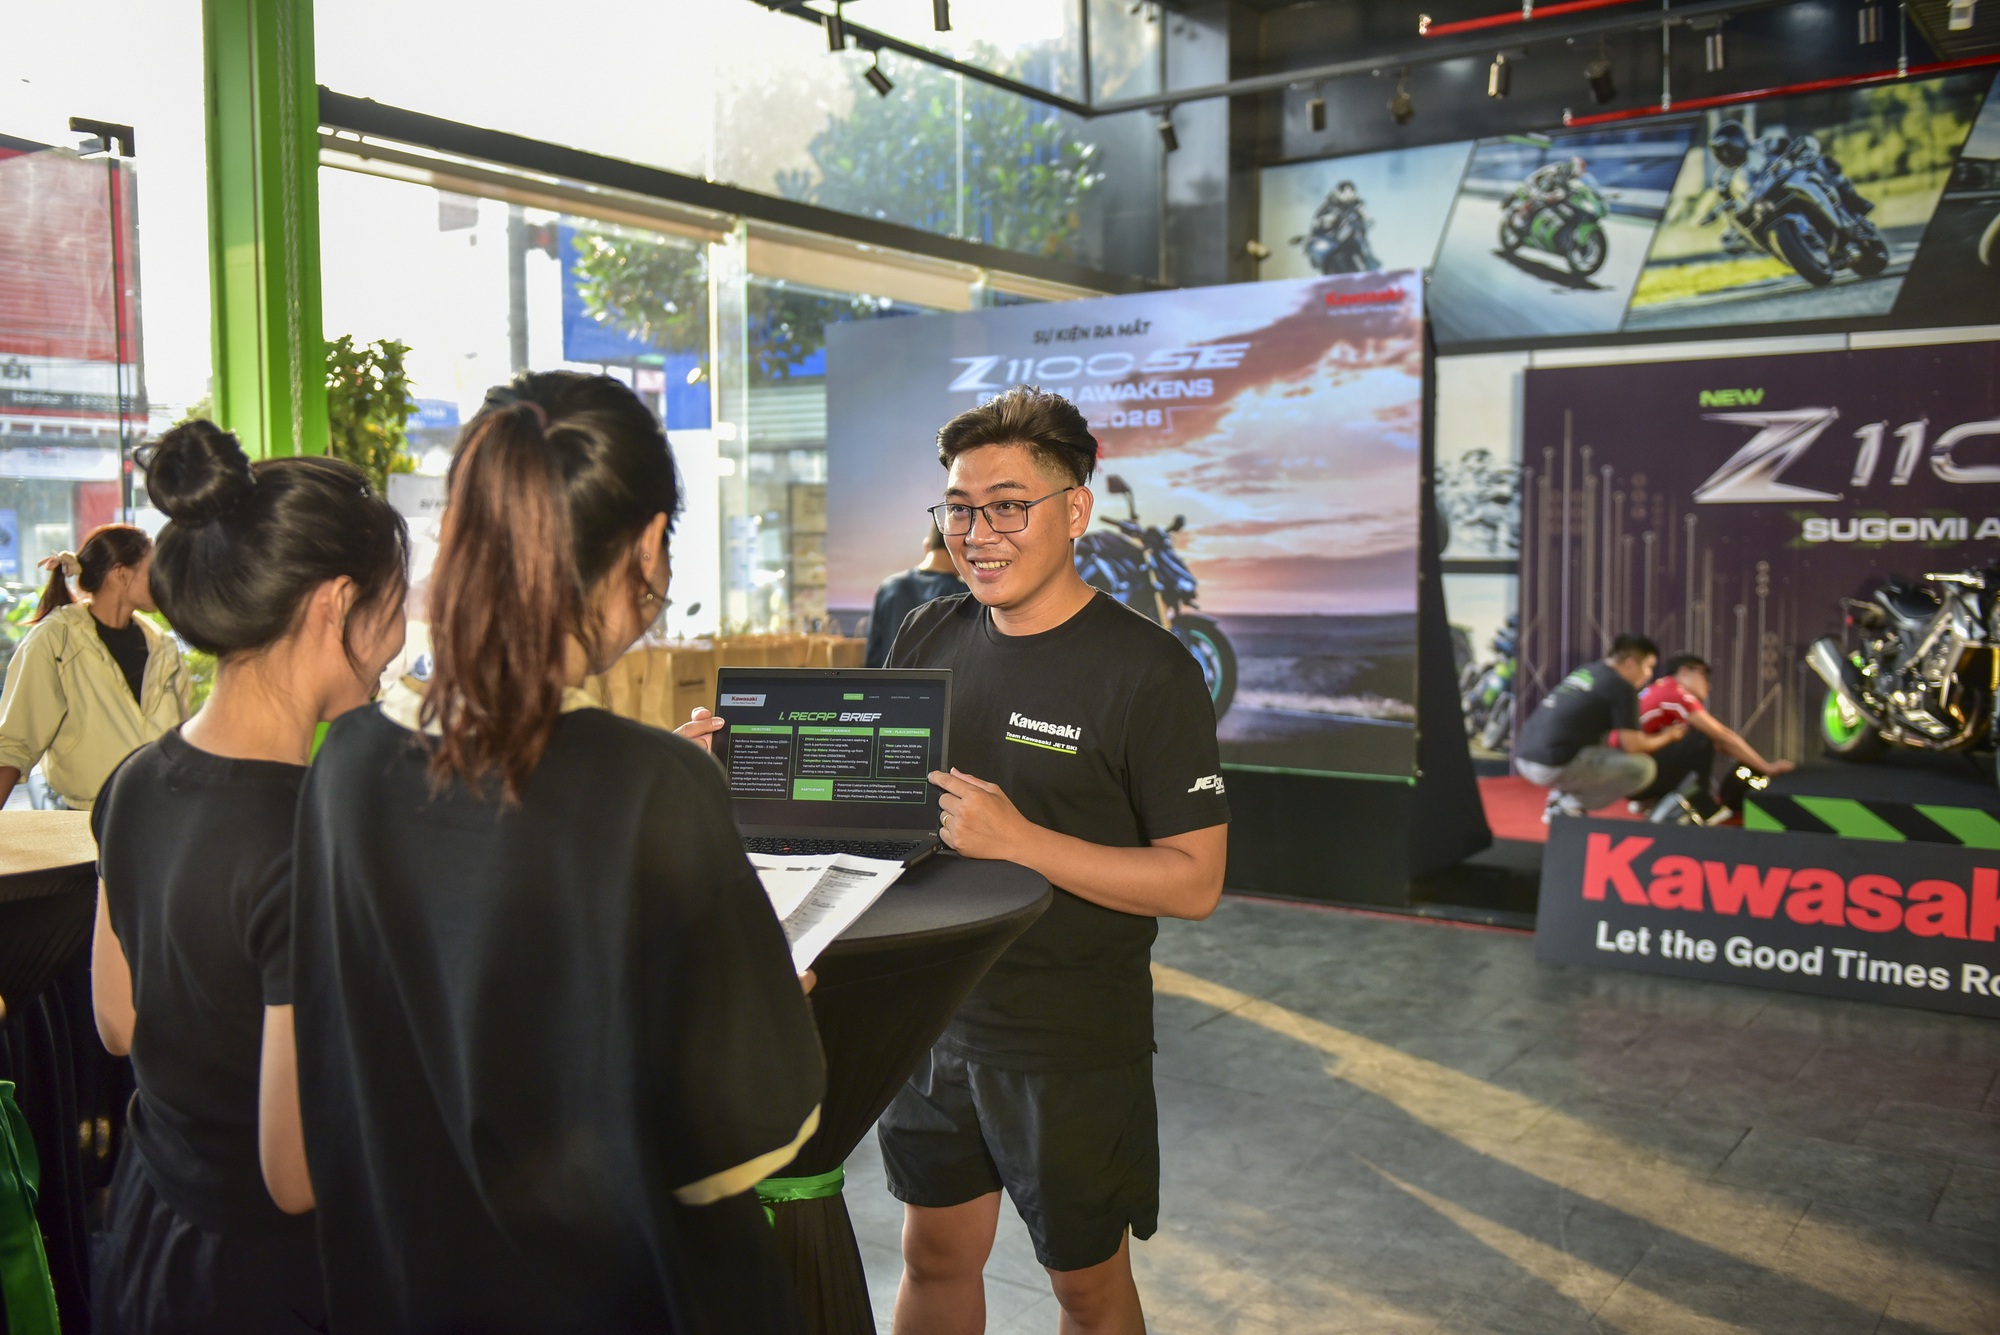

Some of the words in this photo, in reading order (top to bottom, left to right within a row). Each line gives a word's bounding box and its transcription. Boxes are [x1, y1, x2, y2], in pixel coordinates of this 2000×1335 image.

[1094, 324, 1113, 338] RA
[947, 351, 1135, 393] Z1100
[1138, 342, 1251, 374] SE
[1077, 378, 1214, 403] AWAKENS
[1698, 387, 1765, 408] NEW
[1802, 517, 1967, 542] SUGOMI
[788, 711, 837, 721] RECAP
[839, 712, 882, 722] BRIEF
[1009, 712, 1082, 740] Kawasaki
[1006, 731, 1021, 740] Team
[1021, 735, 1052, 746] Kawasaki
[1595, 921, 1651, 955] Let
[1659, 927, 1718, 964] the
[1725, 936, 1824, 977] Good
[1832, 946, 1951, 991] Times
